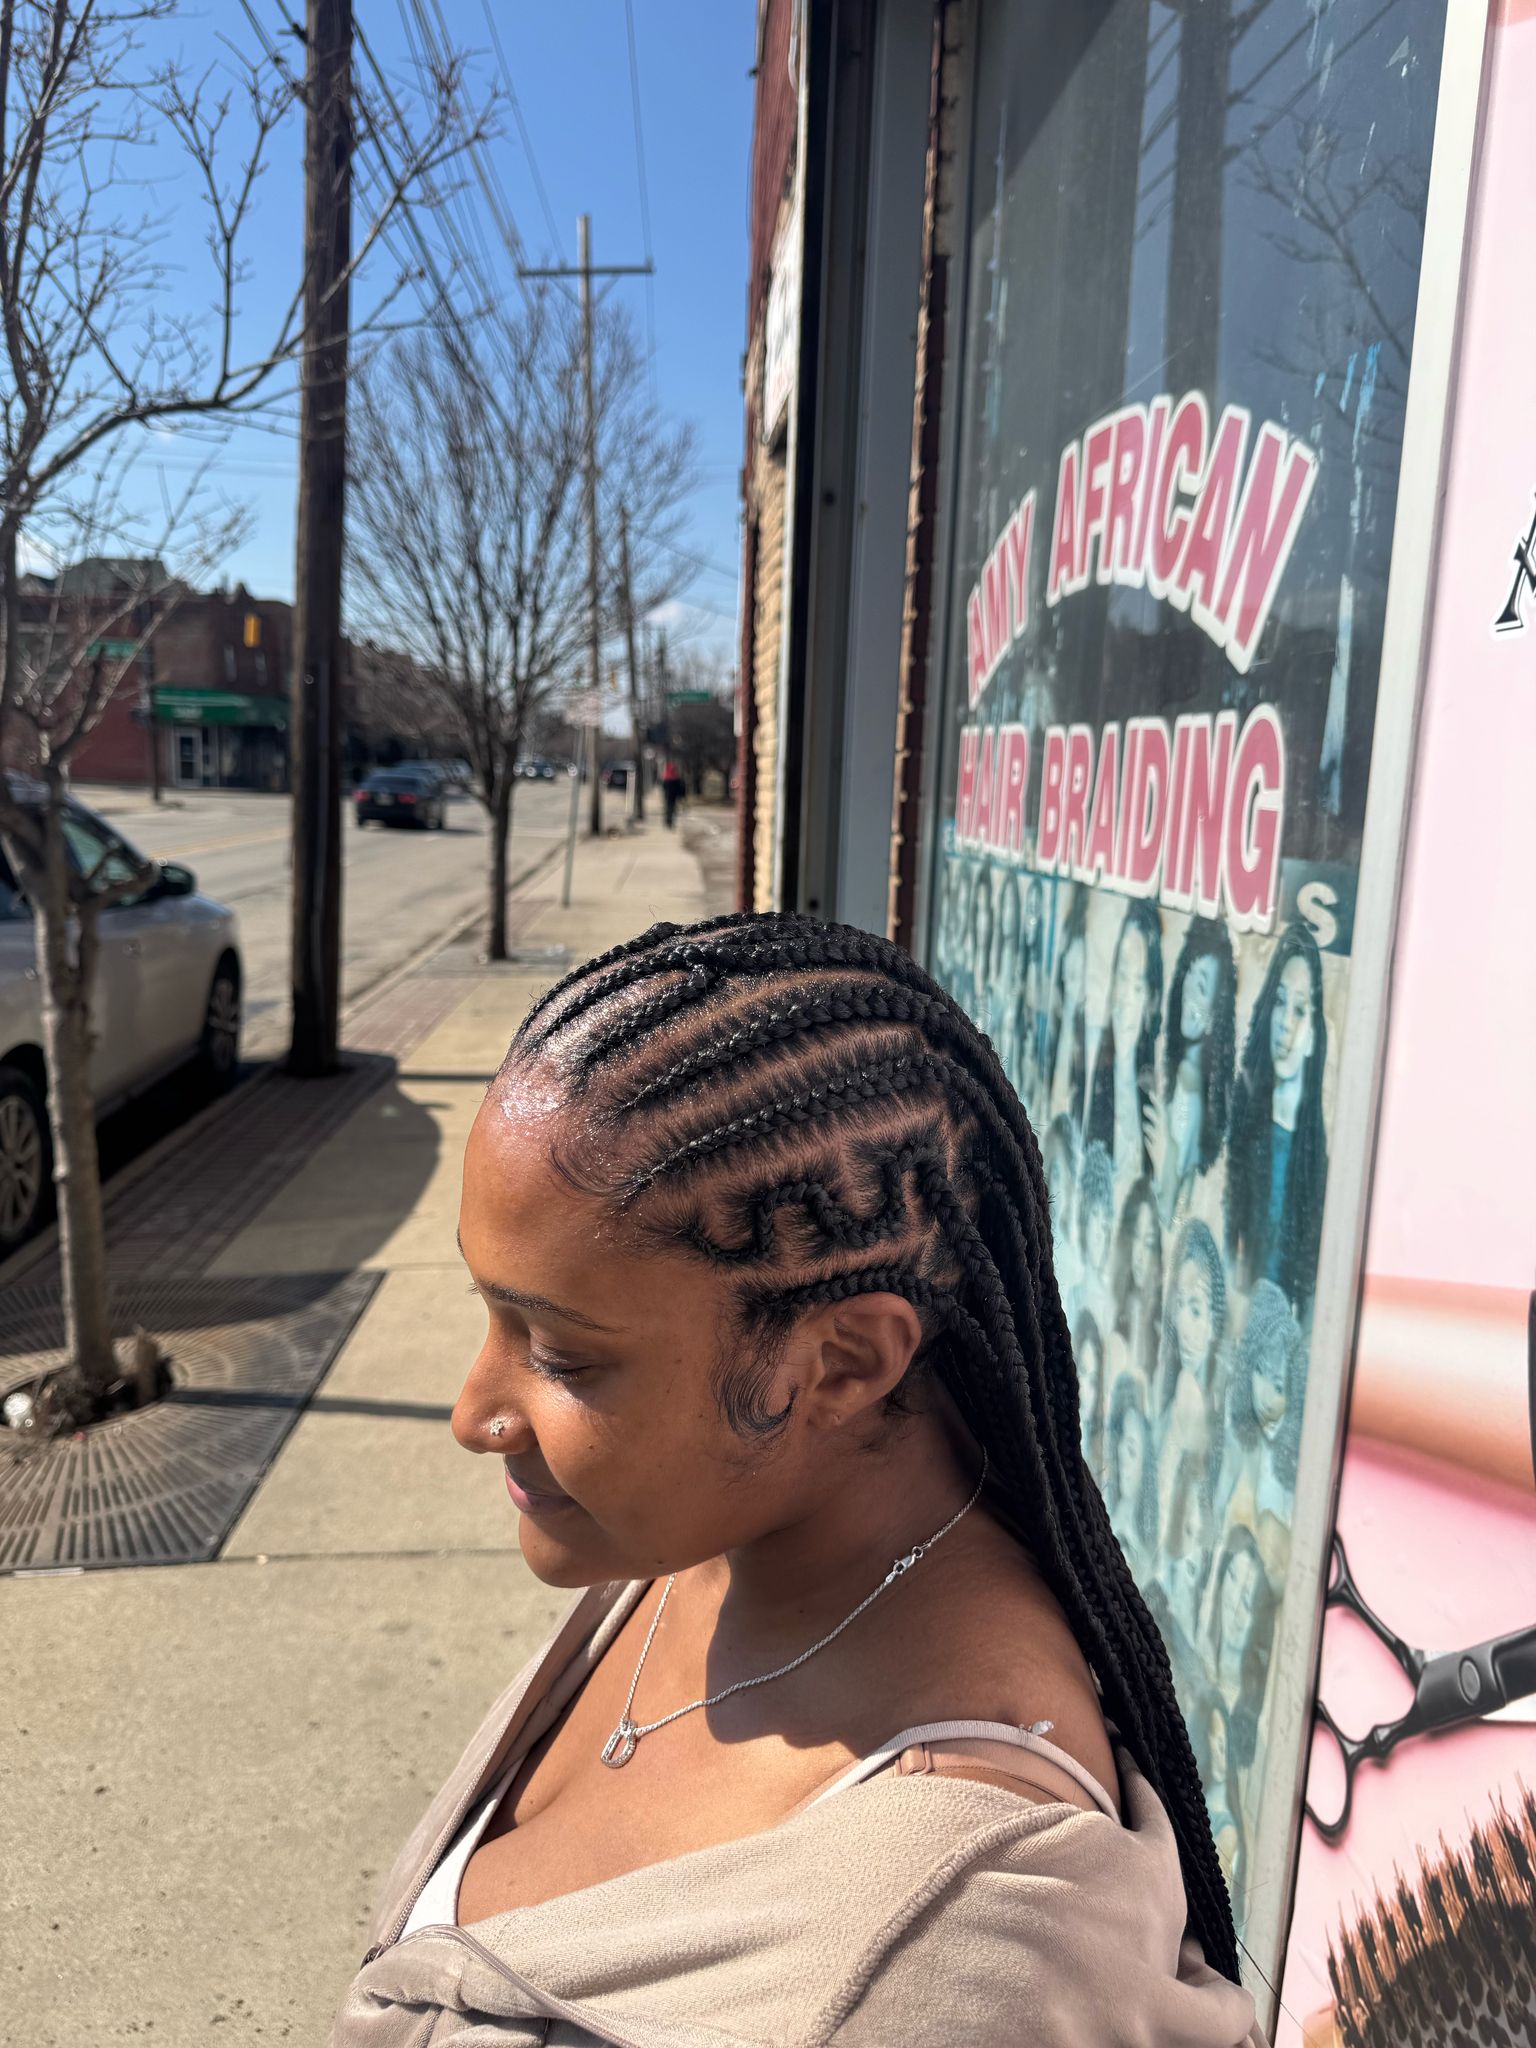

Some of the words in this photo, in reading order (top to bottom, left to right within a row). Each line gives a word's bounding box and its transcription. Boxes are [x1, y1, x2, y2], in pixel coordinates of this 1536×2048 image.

[967, 488, 1037, 711] AMY
[1046, 389, 1321, 675] AFRICAN
[954, 724, 1031, 860] HAIR
[1036, 703, 1285, 935] BRAIDING
